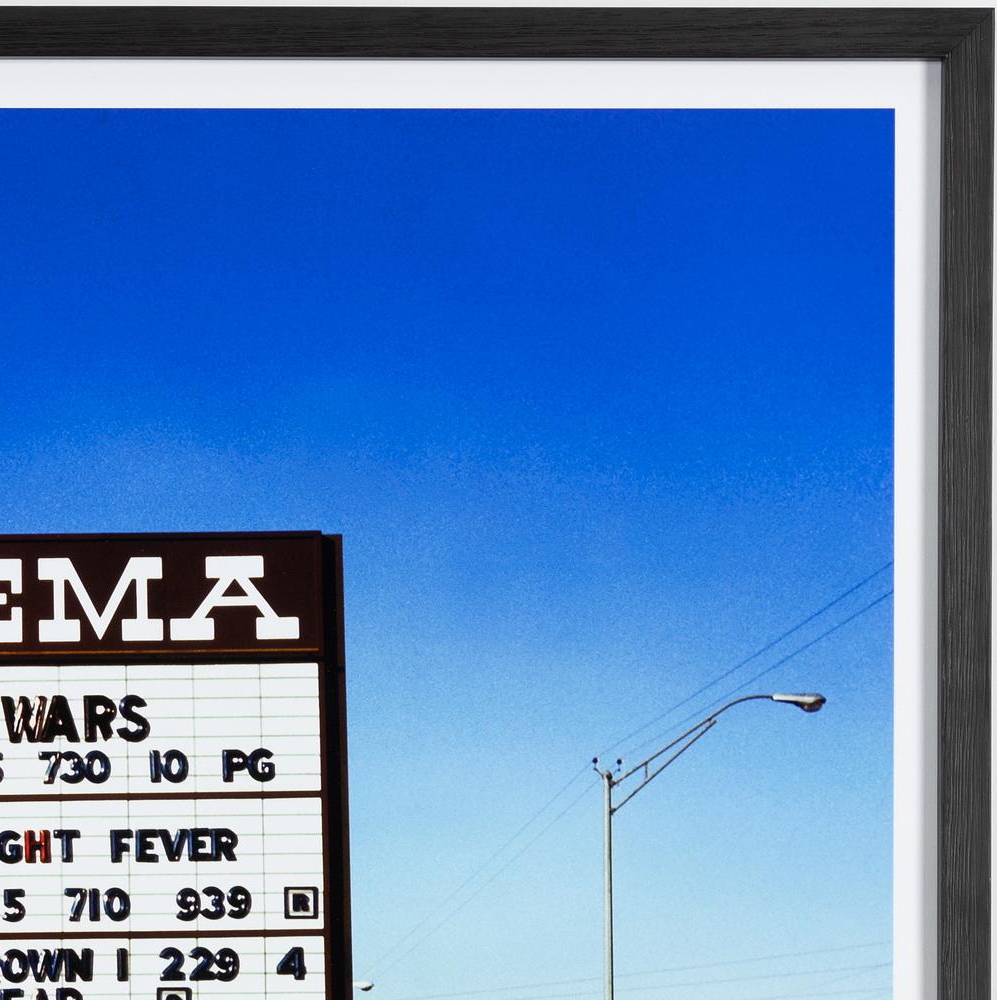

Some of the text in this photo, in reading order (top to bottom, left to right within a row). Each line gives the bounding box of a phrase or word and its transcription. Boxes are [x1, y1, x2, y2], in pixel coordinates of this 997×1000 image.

[1, 694, 151, 744] WARS
[38, 750, 112, 785] 730
[149, 749, 190, 784] 10
[222, 747, 276, 783] PG
[110, 828, 239, 864] FEVER
[2, 888, 26, 923] 5
[64, 887, 131, 922] 710
[176, 886, 252, 921] 939
[159, 946, 240, 982] 229
[276, 946, 308, 981] 4
